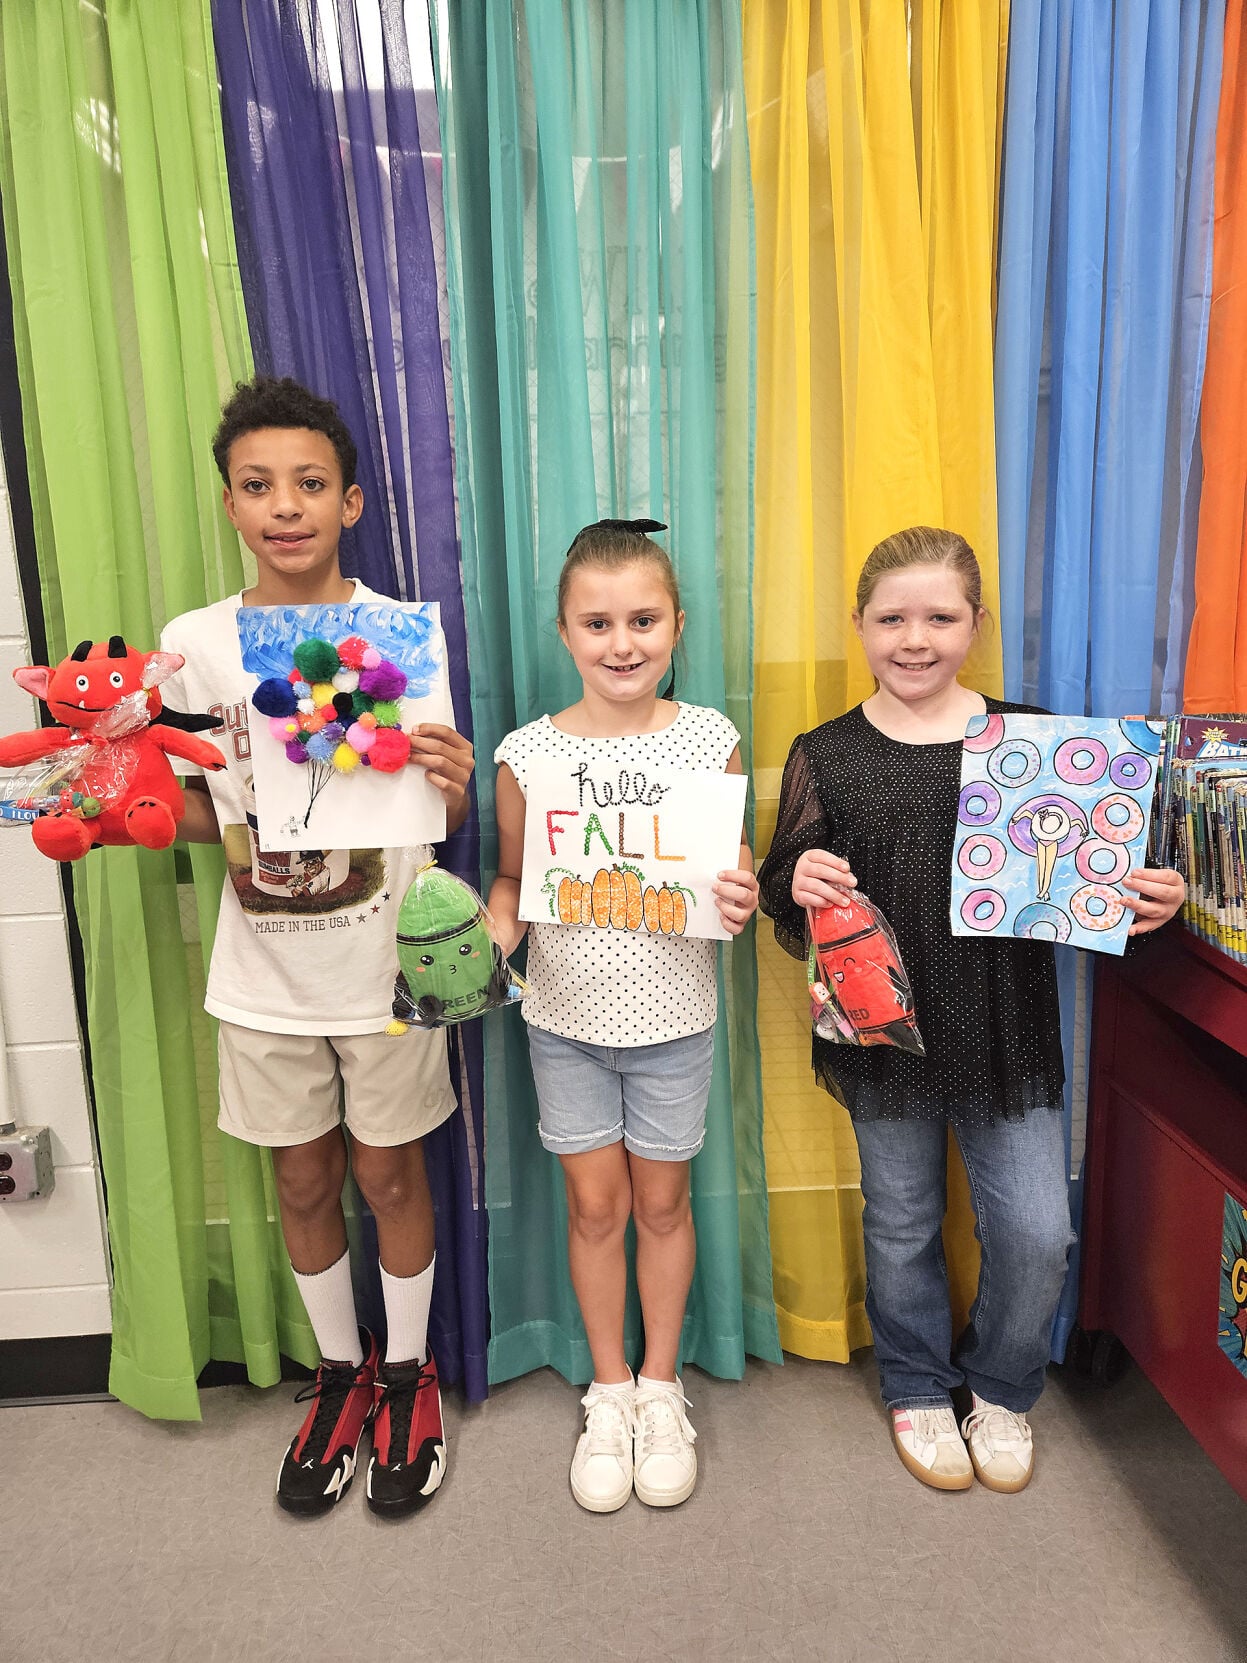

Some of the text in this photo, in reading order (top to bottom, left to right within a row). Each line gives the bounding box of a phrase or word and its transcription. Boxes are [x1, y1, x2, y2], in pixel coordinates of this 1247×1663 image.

[571, 762, 672, 808] hello
[546, 810, 687, 862] FALL
[255, 915, 351, 934] MADE IN THE USA
[442, 985, 490, 1012] REEN
